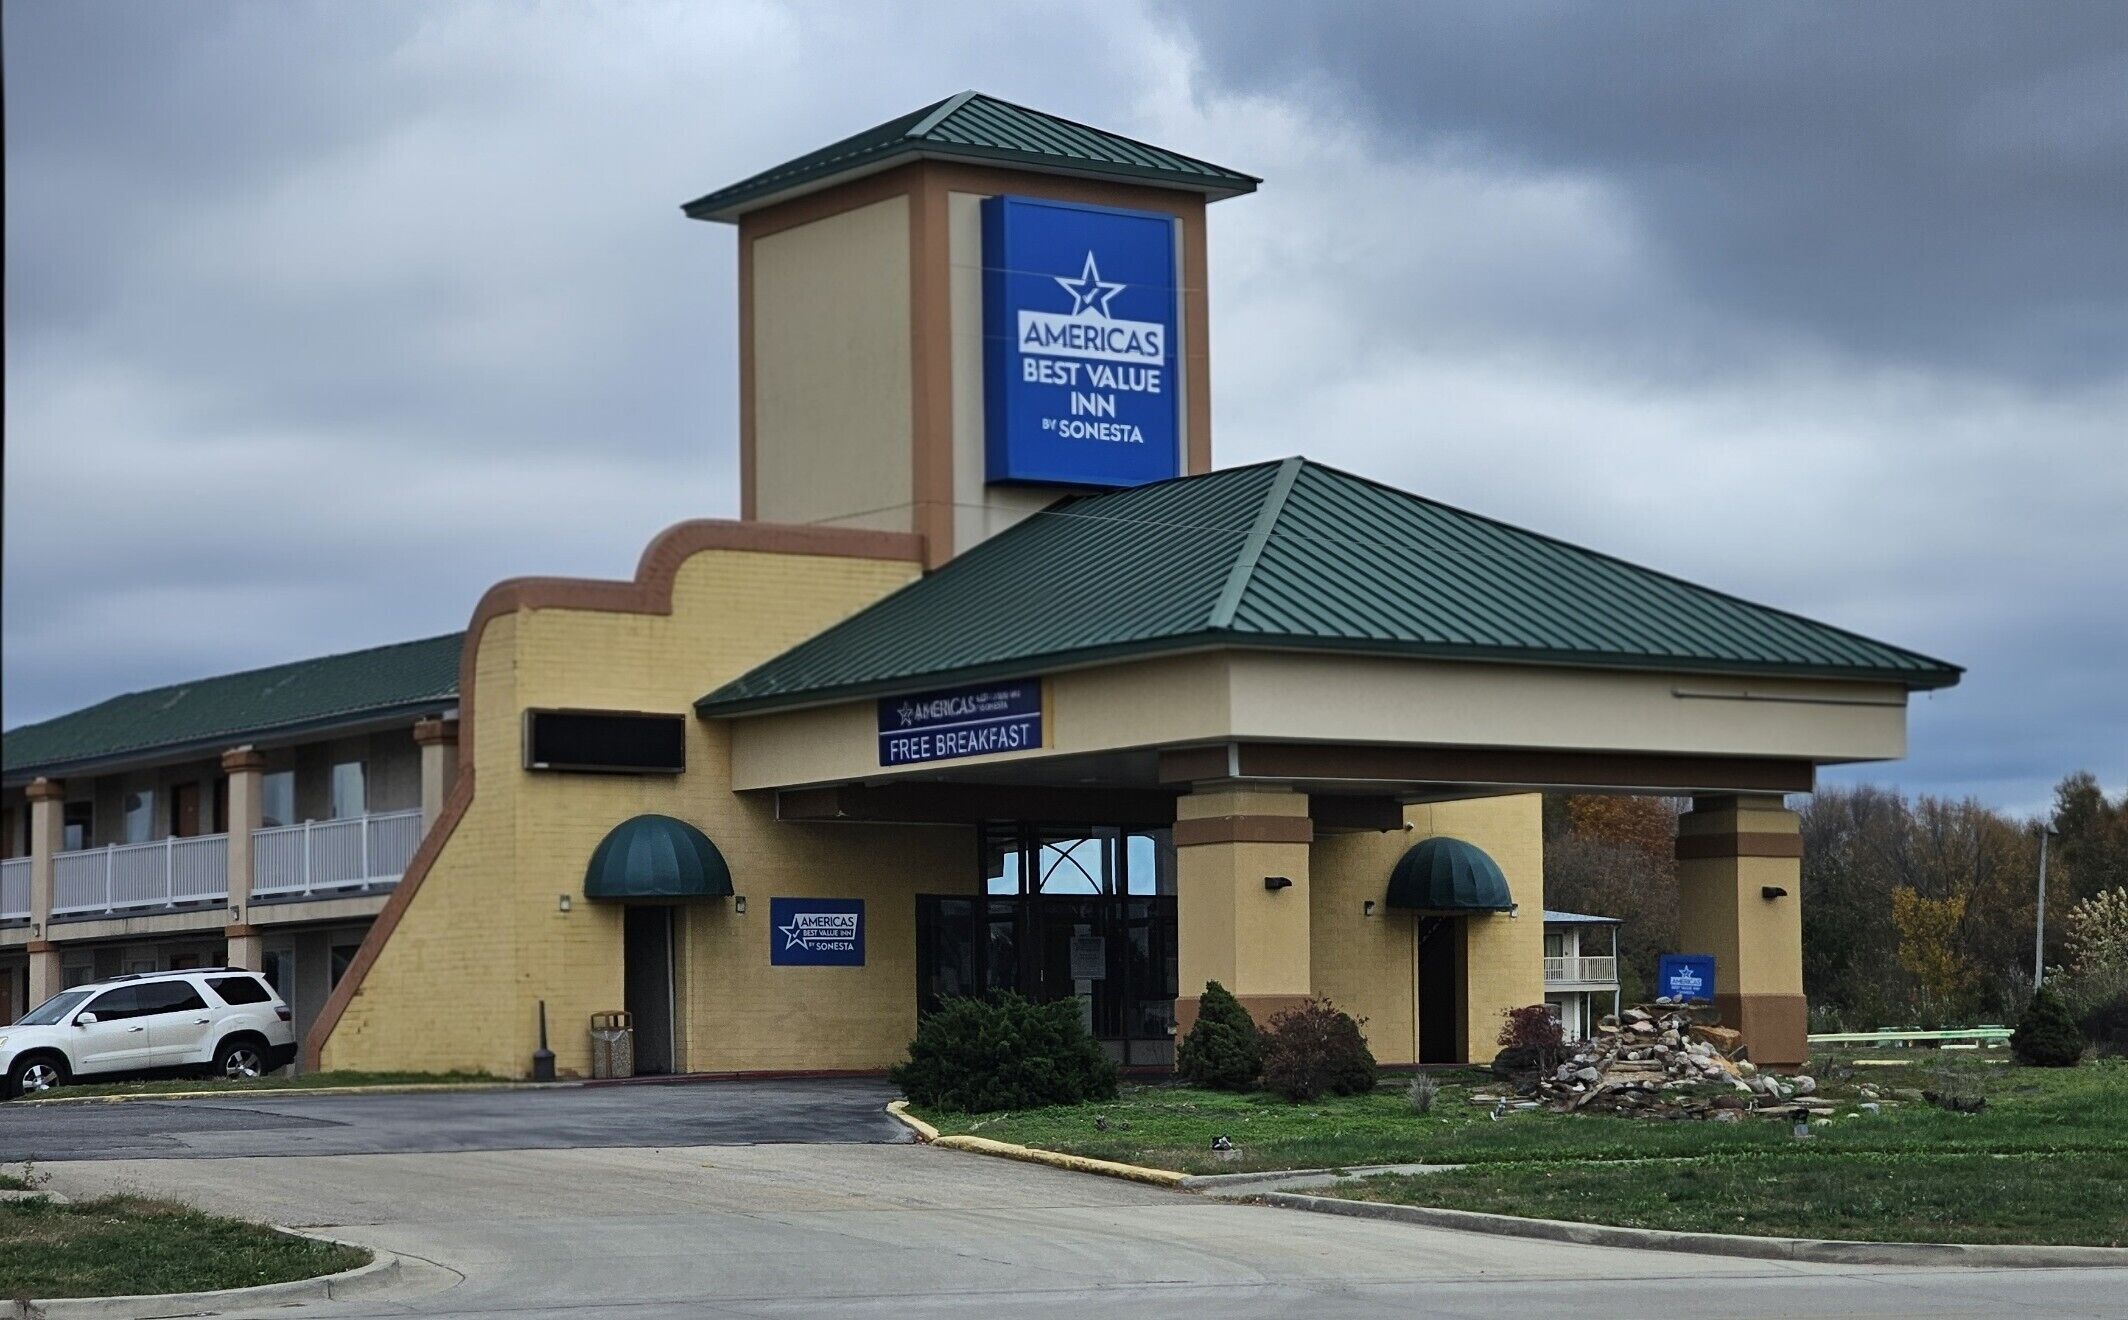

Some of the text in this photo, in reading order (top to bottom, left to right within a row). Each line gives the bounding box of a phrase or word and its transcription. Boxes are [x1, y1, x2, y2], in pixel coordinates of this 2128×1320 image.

[1024, 321, 1159, 357] AMERICAS
[1023, 358, 1161, 393] BEST VALUE
[1070, 391, 1116, 418] INN
[1041, 418, 1144, 444] BY SONESTA
[914, 695, 976, 721] AMERICAS
[890, 724, 1030, 761] FREE BREAKFAST
[801, 916, 854, 927] AMERICAS
[803, 929, 852, 937] BEST VALUE INN
[816, 942, 854, 951] SONESTA
